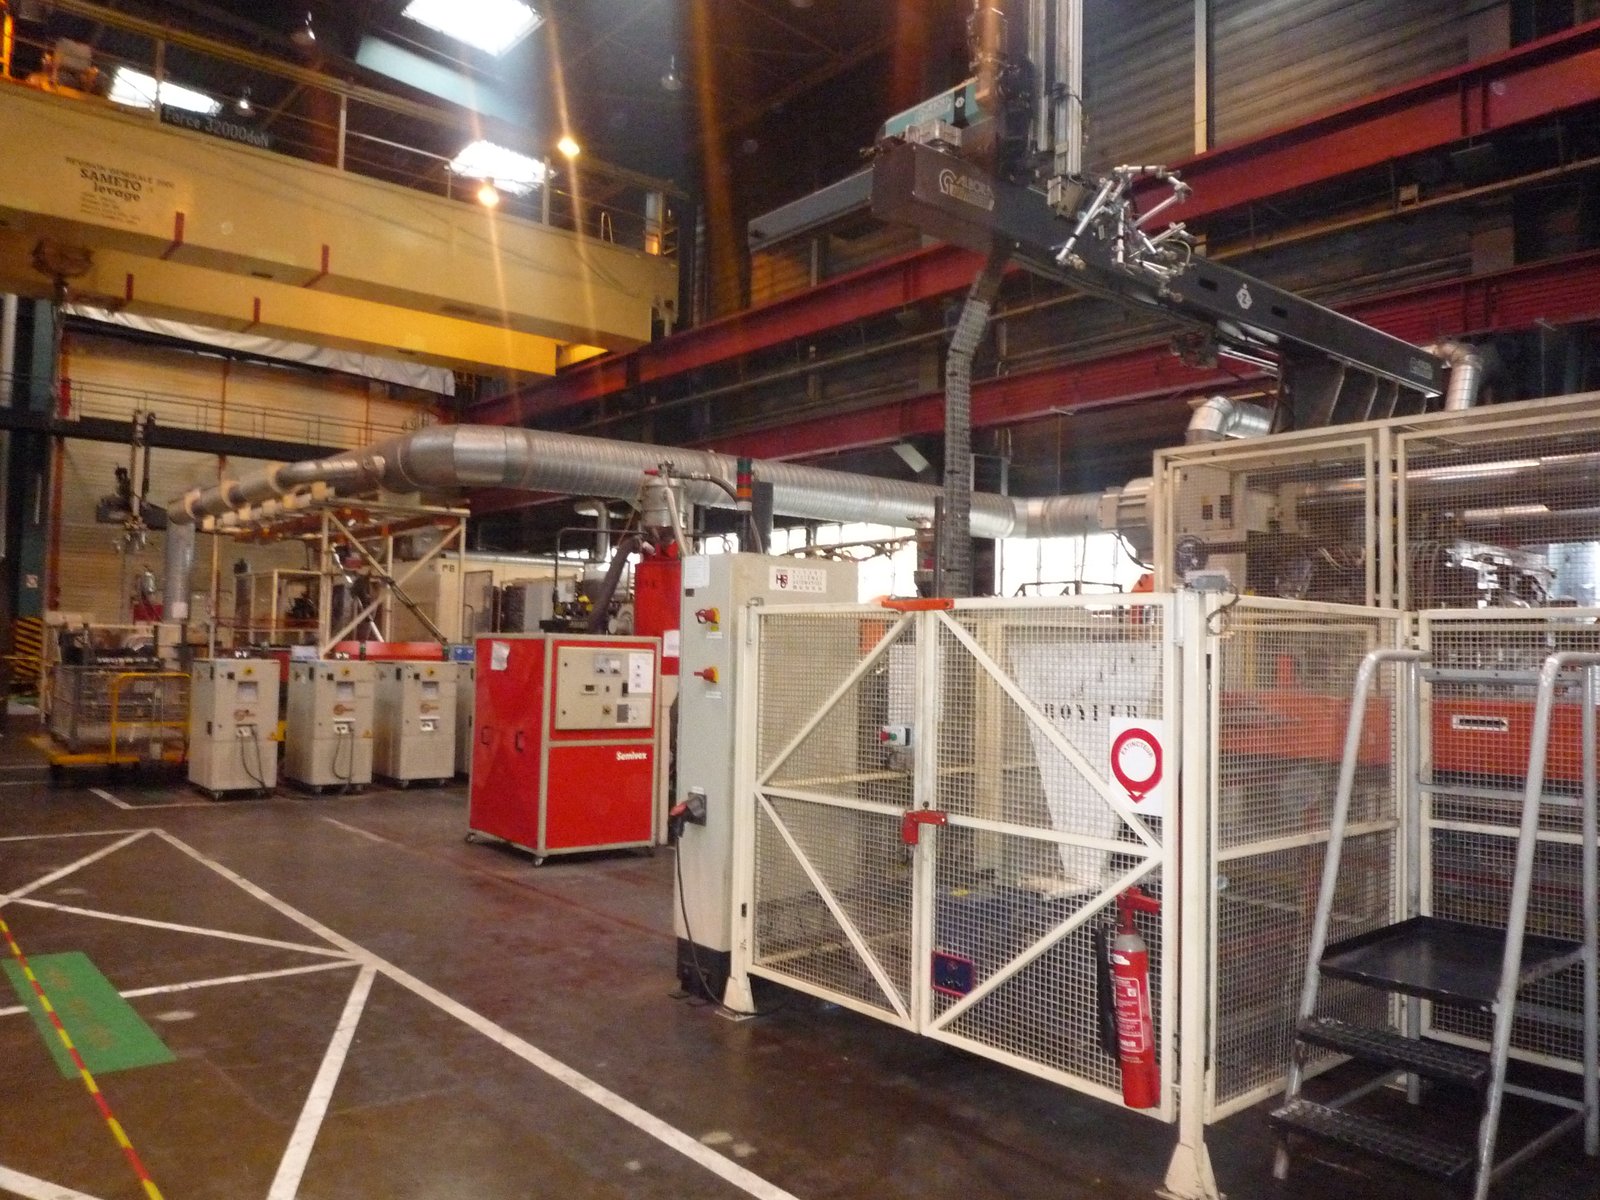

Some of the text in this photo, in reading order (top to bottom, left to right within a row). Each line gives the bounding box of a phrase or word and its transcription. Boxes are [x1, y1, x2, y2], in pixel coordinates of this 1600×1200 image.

[80, 168, 142, 192] SAMETO
[94, 181, 141, 202] levage
[1121, 741, 1154, 758] EXTINCTEUR
